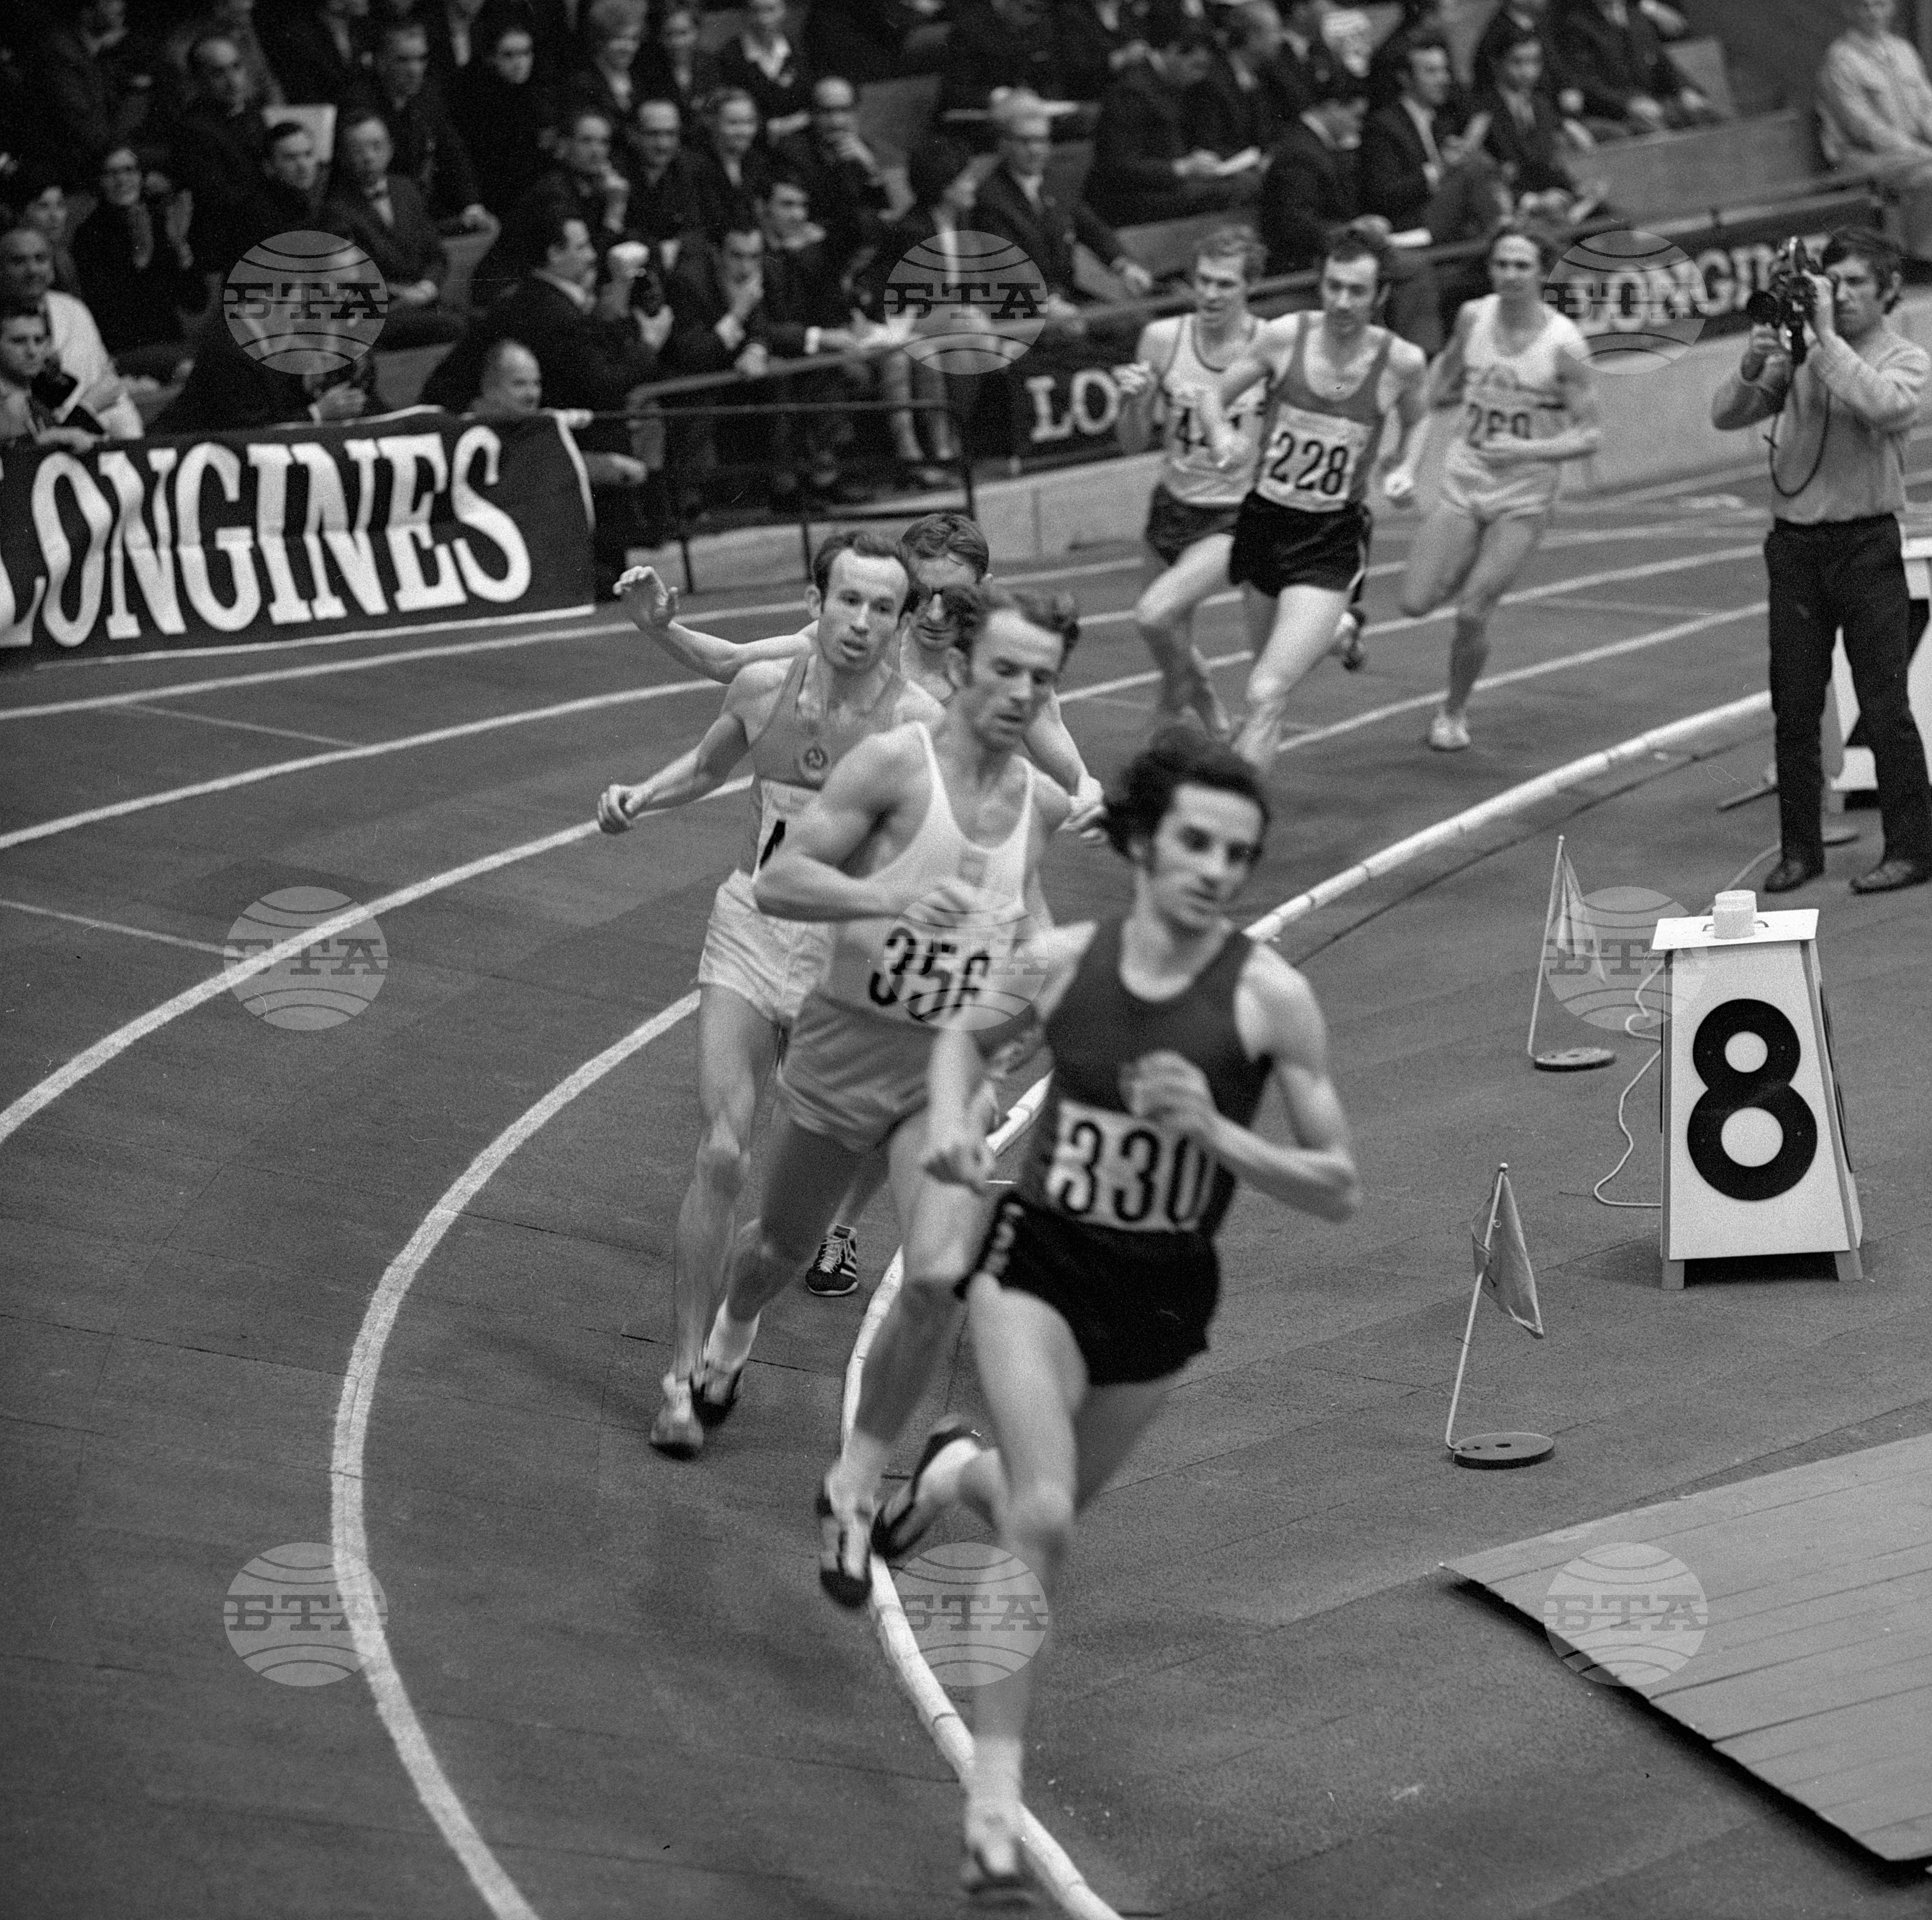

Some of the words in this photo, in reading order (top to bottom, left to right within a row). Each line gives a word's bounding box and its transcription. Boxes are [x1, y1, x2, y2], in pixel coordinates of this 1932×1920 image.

[1269, 431, 1349, 496] 228
[1687, 998, 1818, 1201] 8
[1059, 1121, 1208, 1226] 330
